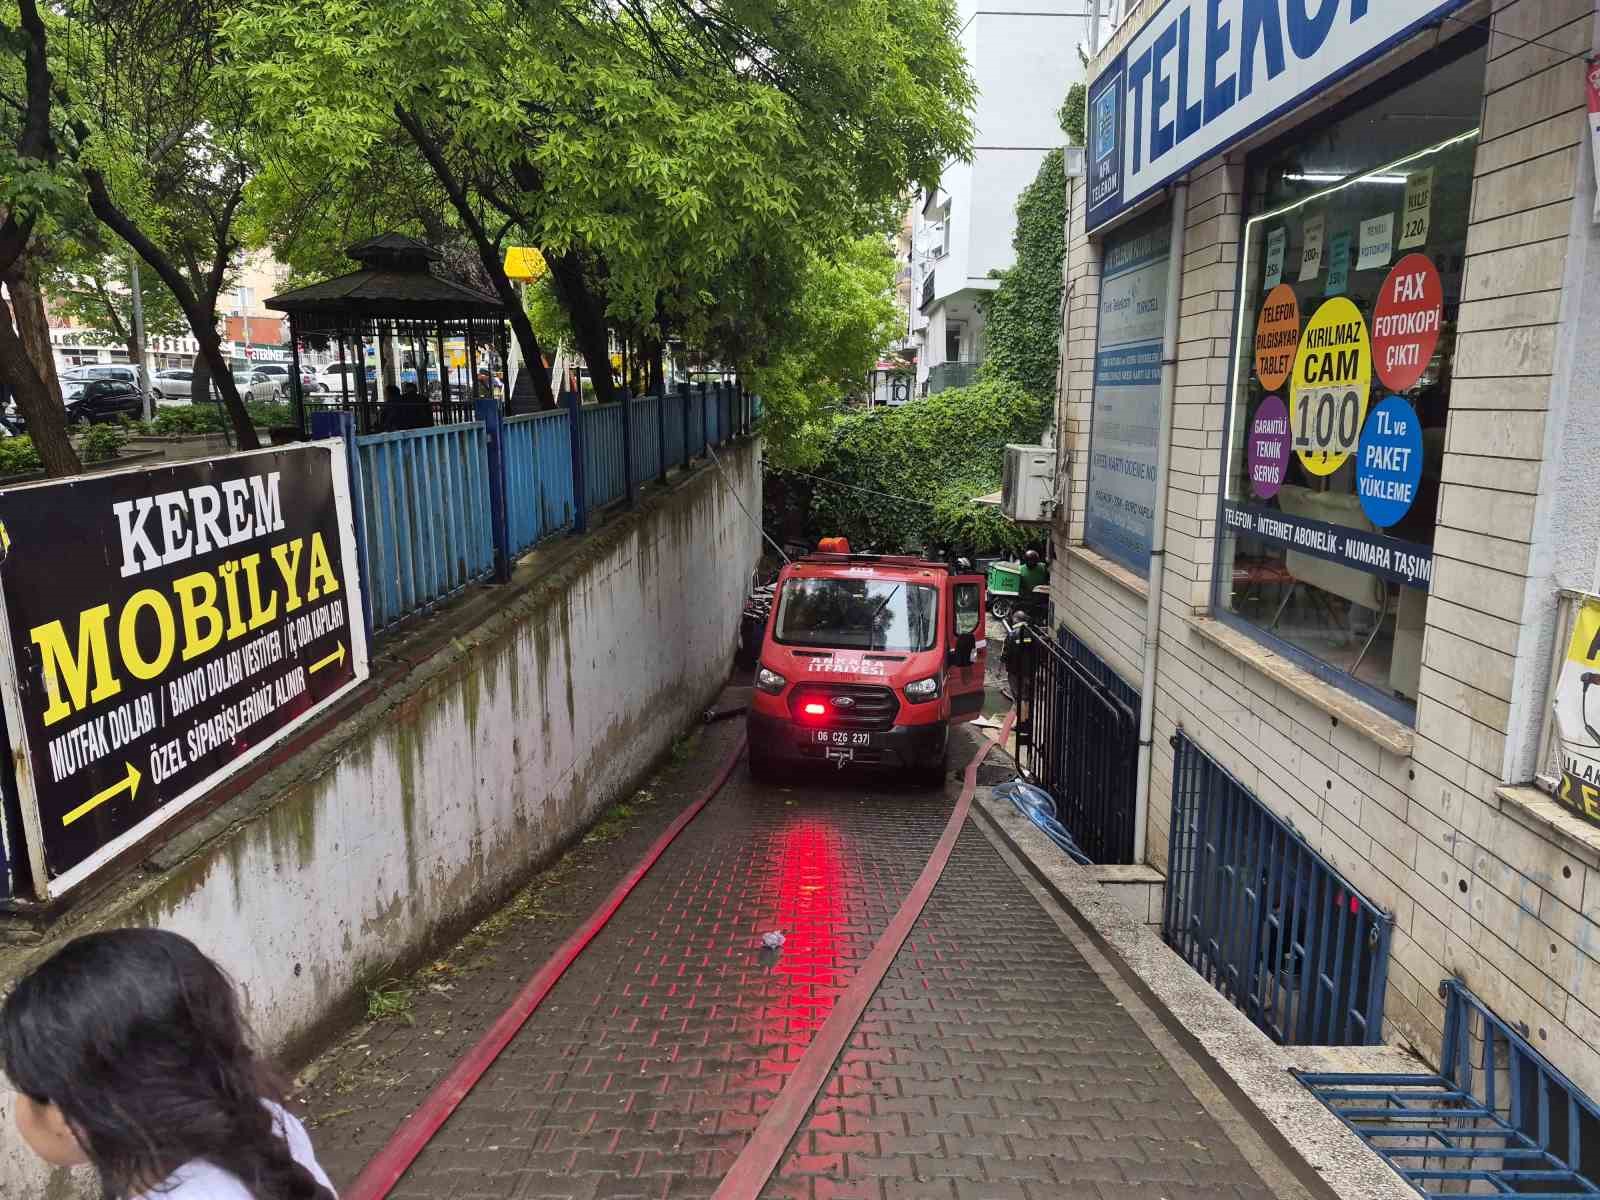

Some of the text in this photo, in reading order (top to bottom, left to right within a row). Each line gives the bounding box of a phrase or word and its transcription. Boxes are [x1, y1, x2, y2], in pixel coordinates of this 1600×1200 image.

[1129, 0, 1367, 175] TELEK
[1393, 272, 1427, 303] FAX
[1263, 303, 1295, 322] TELEFON
[1375, 304, 1440, 337] FOTOKOPİ
[1256, 328, 1298, 350] BİLGİSAYAR
[1306, 321, 1361, 350] KIRILMAZ
[1260, 354, 1291, 376] TABLET
[1303, 348, 1360, 384] CAM
[1386, 343, 1420, 373] ÇIKTI
[1254, 416, 1288, 435] GARANTİLİ
[1295, 391, 1359, 448] 100
[1376, 411, 1407, 436] TL ve
[1256, 438, 1282, 460] TEKNİK
[1365, 445, 1412, 472] PAKET
[1253, 465, 1280, 484] SERVİS
[1359, 474, 1412, 503] YÜKLEME
[113, 471, 285, 578] KEREM
[1224, 508, 1252, 530] TELEFON
[1257, 514, 1293, 541] İNTERNET
[1294, 525, 1337, 554] ABONELİK
[1345, 538, 1390, 570] NUMARA
[30, 532, 339, 727] MOBİLYA
[48, 727, 108, 783] MUTFAK
[109, 693, 156, 750] DOLABI
[169, 674, 206, 718] BANYO
[207, 655, 243, 697] DOLABI
[242, 630, 282, 678] VESTİYER
[298, 613, 314, 648] ODA
[313, 599, 343, 640] KAPILARI
[150, 665, 305, 785] ÖZEL SİPARİŞLERİNİZ ALINIR
[817, 730, 828, 741] 06
[852, 732, 868, 743] 237
